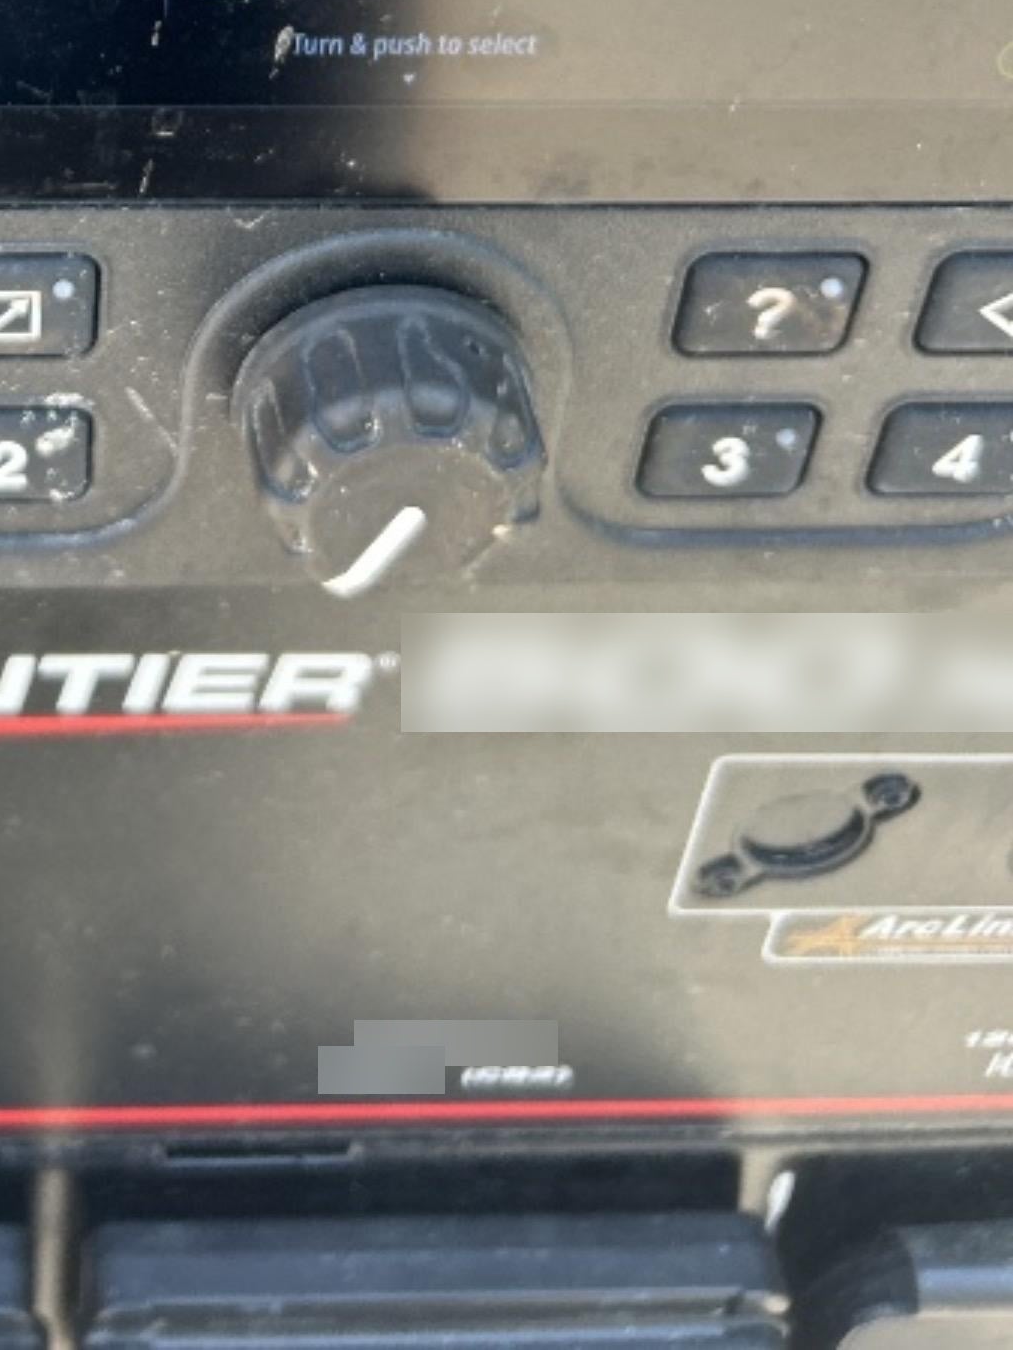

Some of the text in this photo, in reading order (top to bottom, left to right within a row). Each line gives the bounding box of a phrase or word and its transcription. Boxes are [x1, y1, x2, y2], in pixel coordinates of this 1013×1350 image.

[293, 32, 537, 61] Turn & push to select
[747, 288, 792, 340] ?
[702, 438, 751, 485] 3
[932, 434, 984, 483] 4
